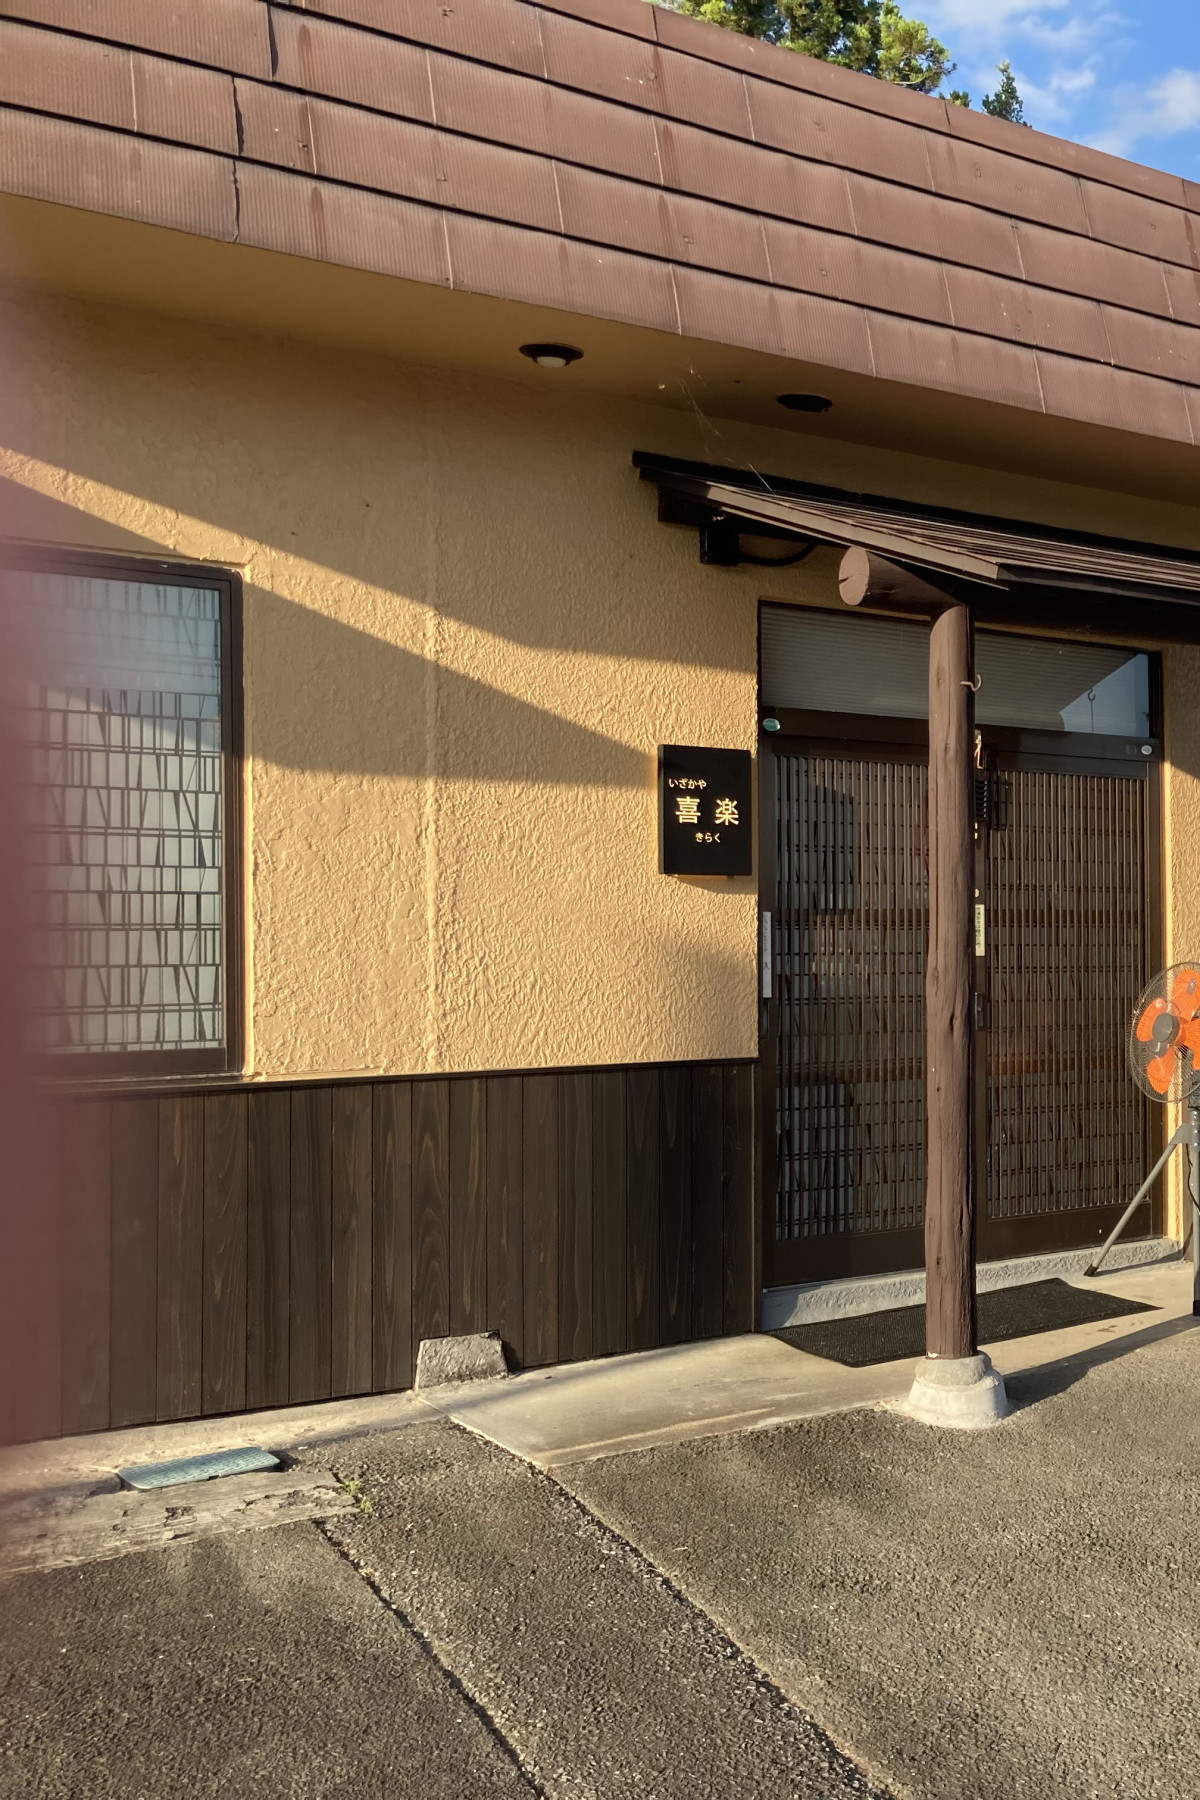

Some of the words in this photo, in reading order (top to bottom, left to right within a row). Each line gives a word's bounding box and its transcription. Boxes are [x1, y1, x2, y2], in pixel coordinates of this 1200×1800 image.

[668, 778, 707, 790] いざかや
[675, 796, 740, 826] 喜楽
[695, 832, 721, 843] きらく
